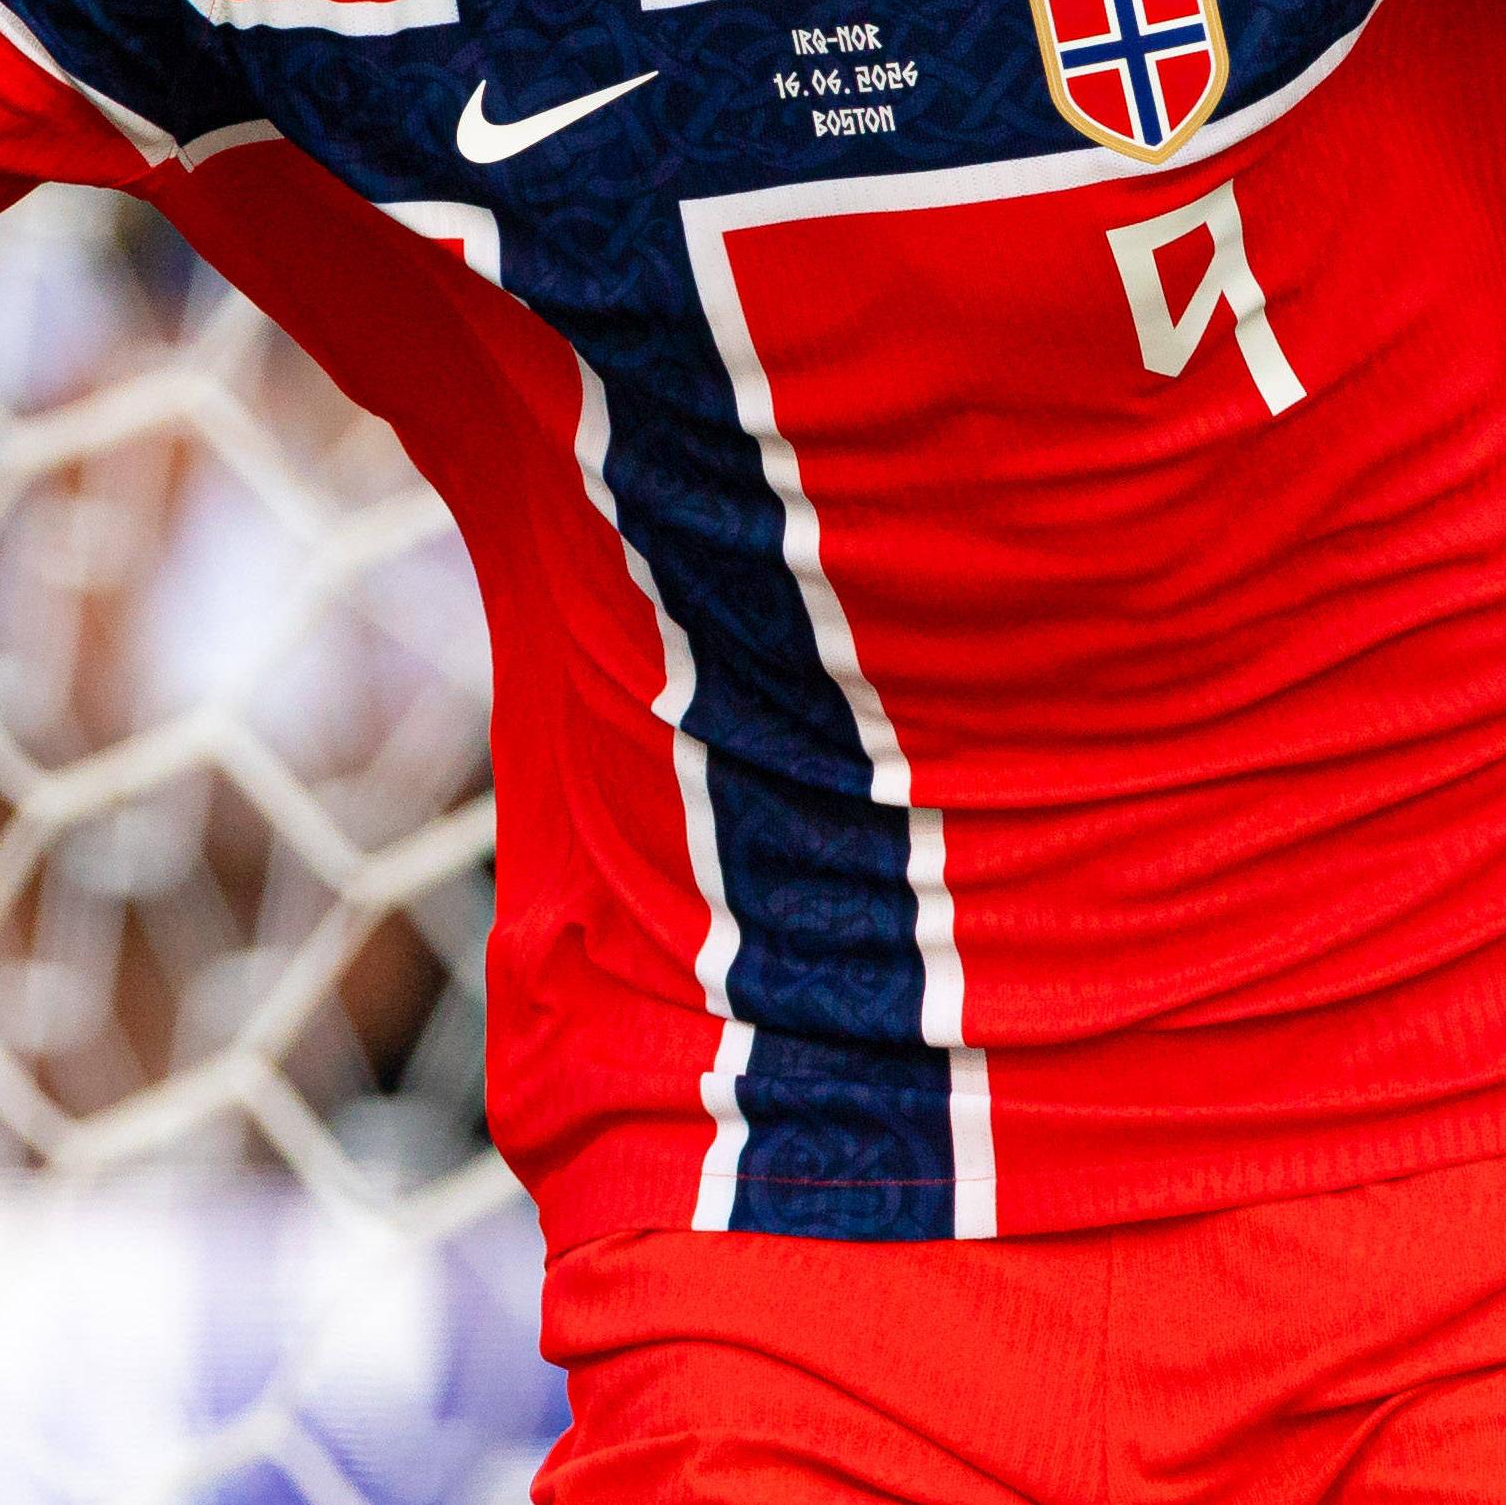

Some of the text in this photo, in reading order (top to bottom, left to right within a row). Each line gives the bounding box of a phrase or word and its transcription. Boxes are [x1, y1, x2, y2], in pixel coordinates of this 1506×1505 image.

[791, 23, 883, 56] IRQ-NOR
[772, 60, 919, 99] 16.06.2026
[812, 105, 896, 138] BOSTON
[1105, 178, 1308, 417] 9
